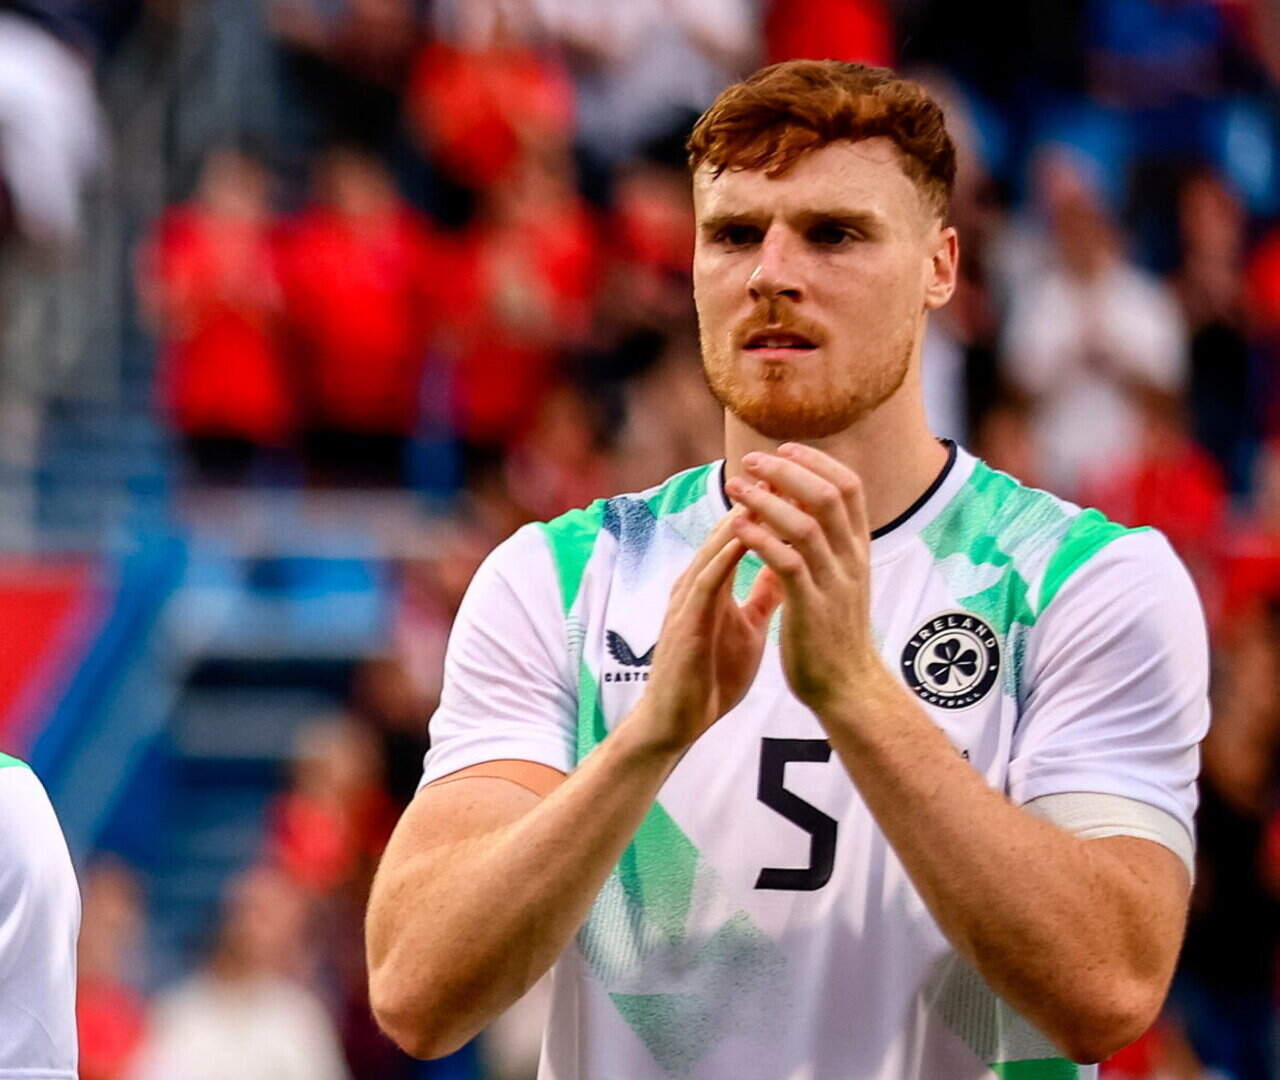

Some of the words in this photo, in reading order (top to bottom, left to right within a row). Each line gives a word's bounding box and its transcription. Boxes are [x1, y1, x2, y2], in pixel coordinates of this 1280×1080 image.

[909, 616, 996, 648] IRELAND
[604, 672, 649, 682] CASTO
[754, 737, 838, 892] 5
